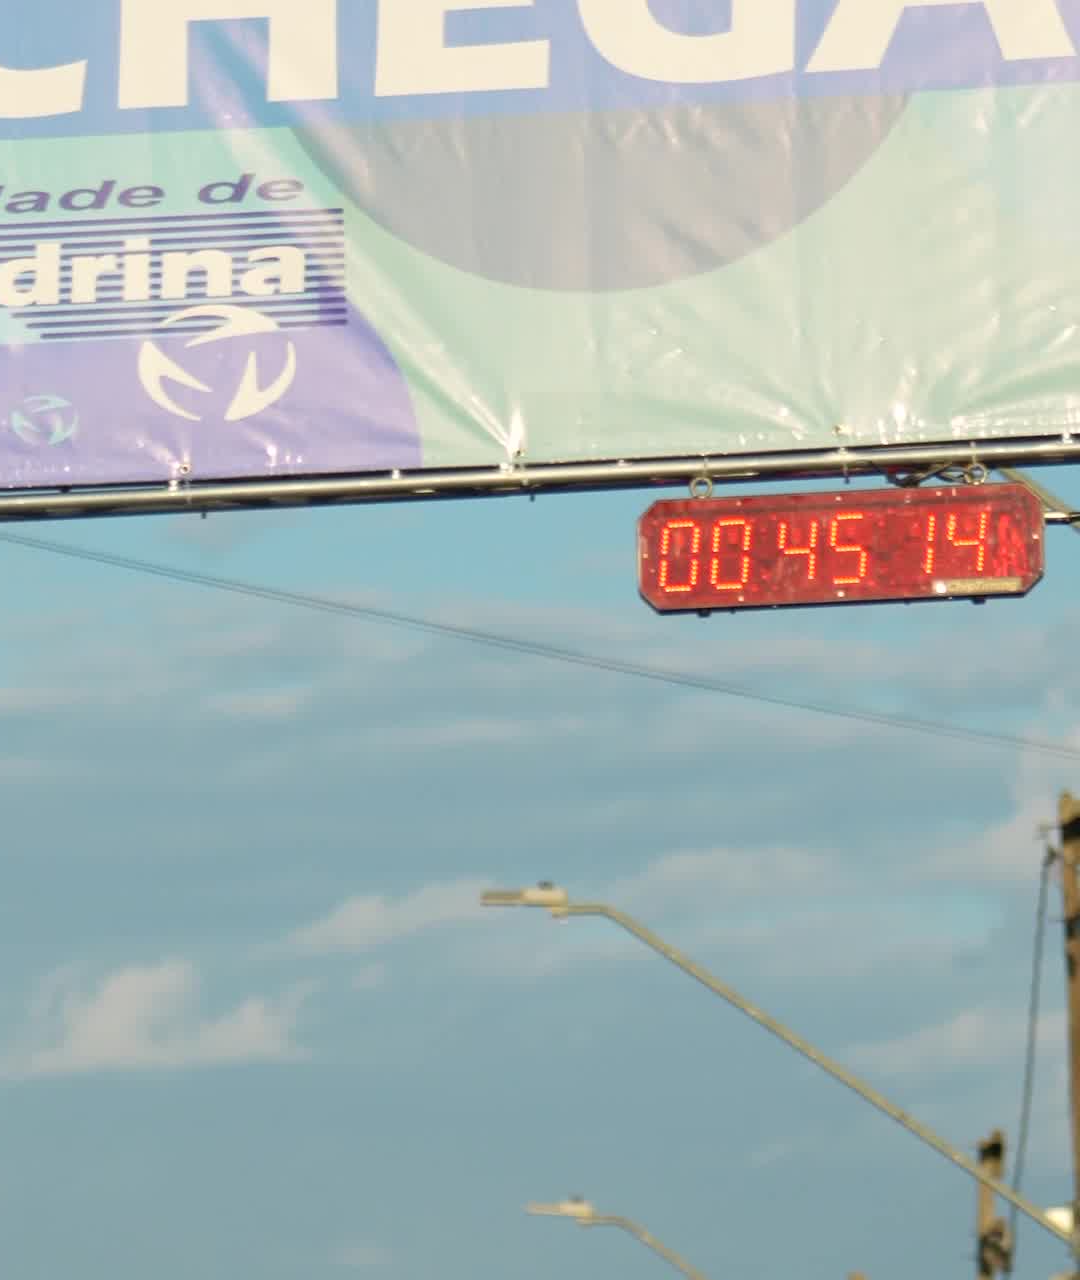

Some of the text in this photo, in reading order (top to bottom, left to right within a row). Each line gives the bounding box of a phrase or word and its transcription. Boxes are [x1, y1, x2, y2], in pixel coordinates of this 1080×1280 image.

[197, 173, 305, 205] de
[658, 511, 988, 593] 00 45 14
